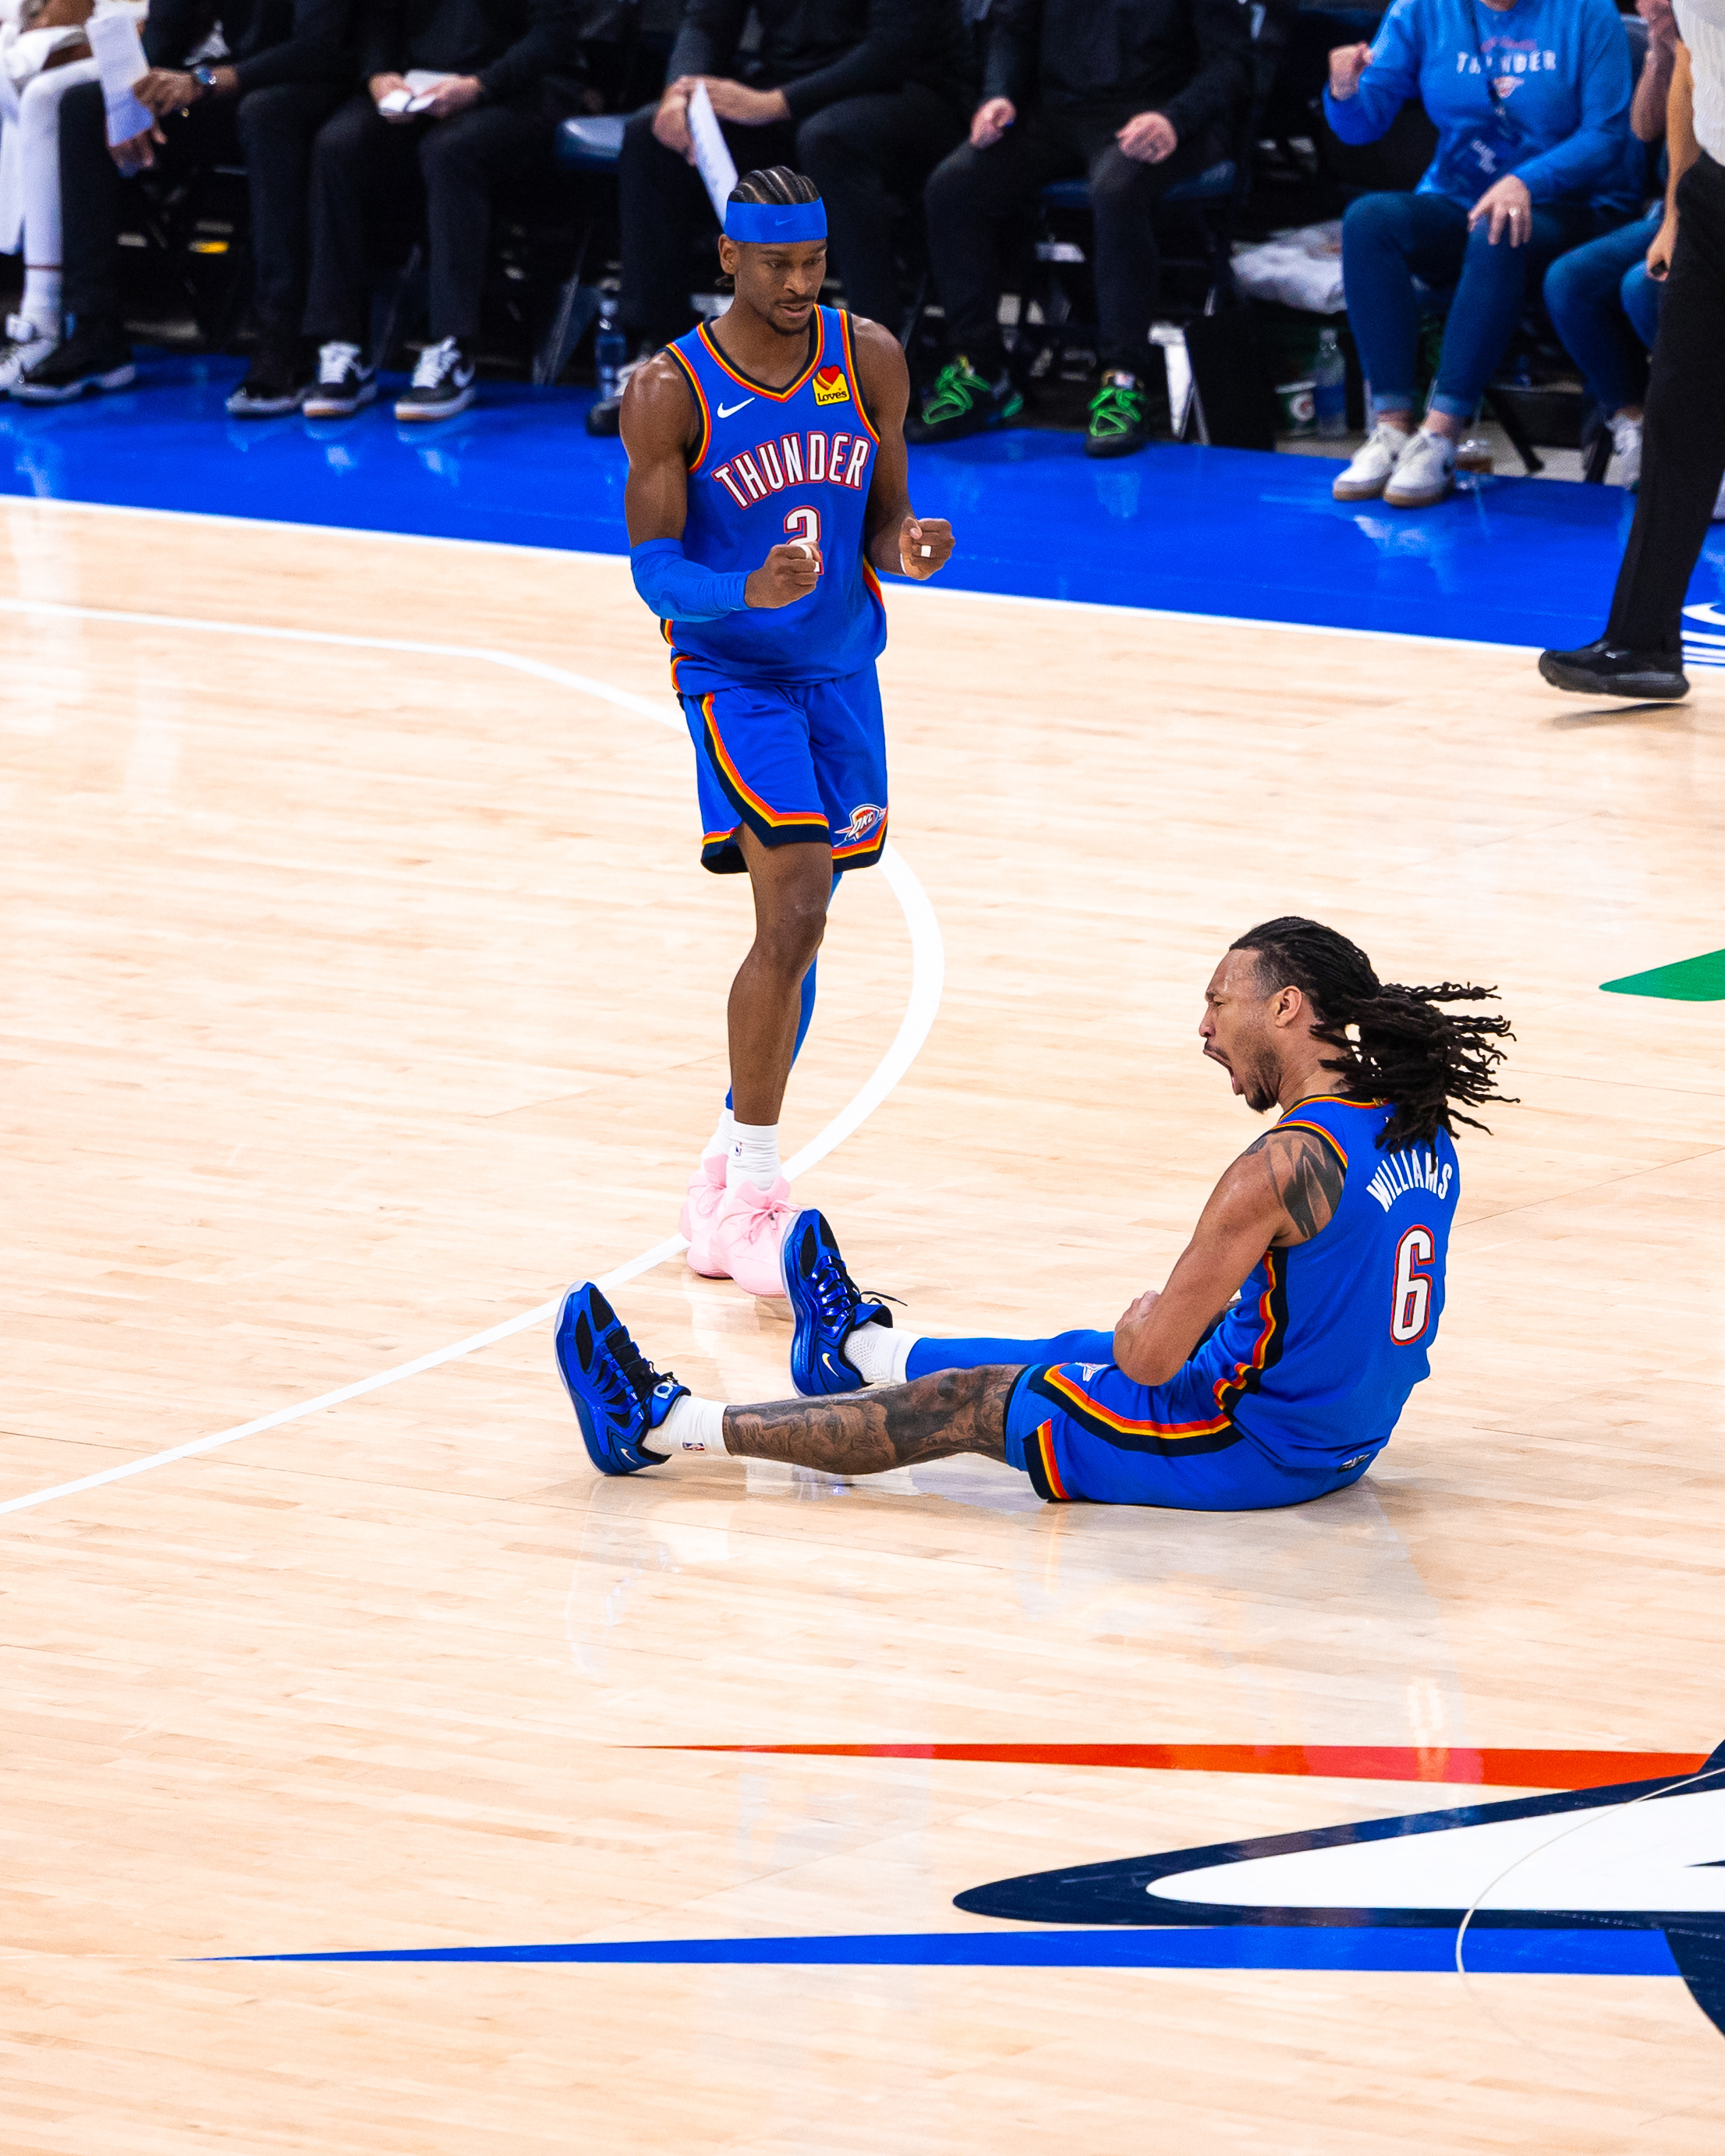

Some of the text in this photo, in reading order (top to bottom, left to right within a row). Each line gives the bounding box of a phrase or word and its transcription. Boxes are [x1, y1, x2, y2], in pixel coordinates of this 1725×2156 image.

[711, 431, 871, 511] THUNDER
[1365, 1149, 1453, 1213] WILLIAMS
[1390, 1224, 1436, 1347] 6
